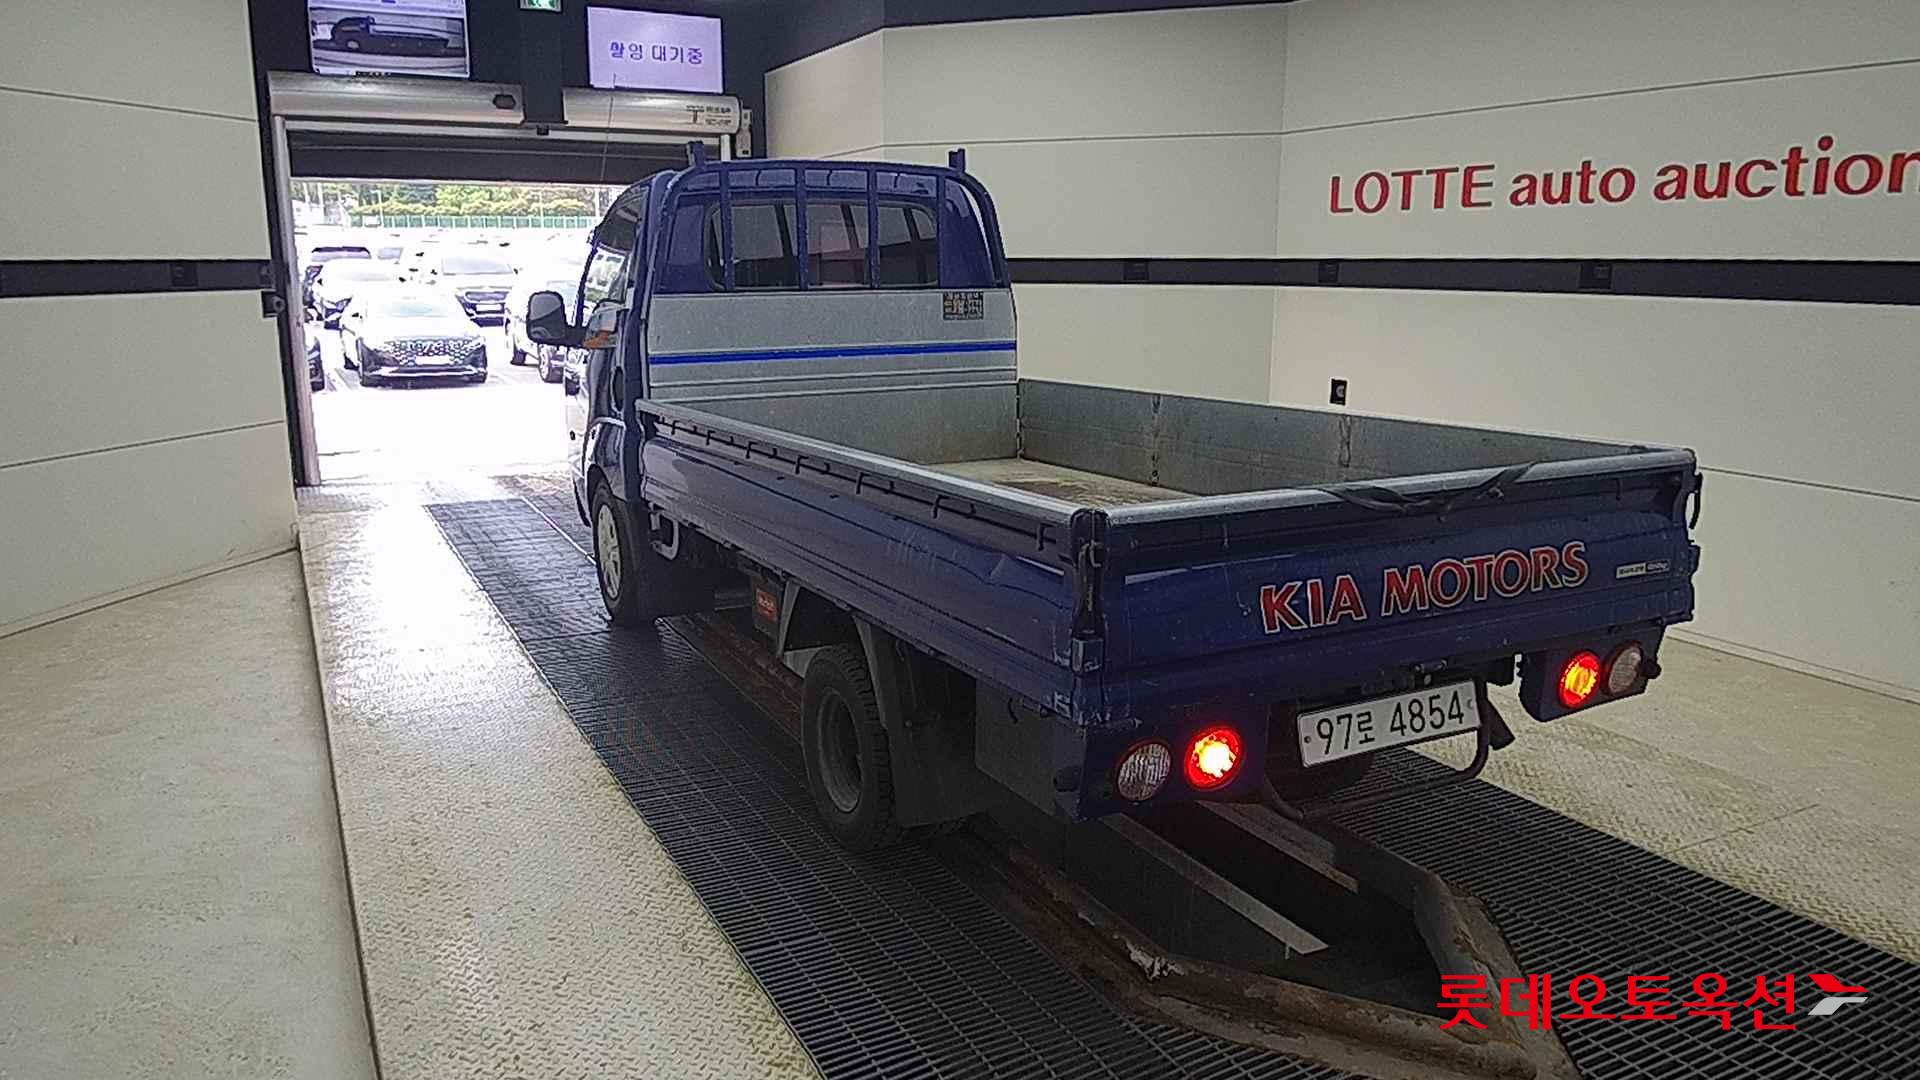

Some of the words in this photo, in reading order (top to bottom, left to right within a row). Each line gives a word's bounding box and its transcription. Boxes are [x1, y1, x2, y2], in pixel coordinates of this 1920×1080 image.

[652, 45, 703, 65] 대기중
[1329, 164, 1496, 213] LOTTE
[1509, 160, 1636, 207] auto
[1654, 136, 1920, 200] auction
[1260, 575, 1367, 634] KIA
[1381, 541, 1588, 616] MOTORS
[1316, 711, 1376, 755] 97로
[1390, 690, 1464, 737] 4854
